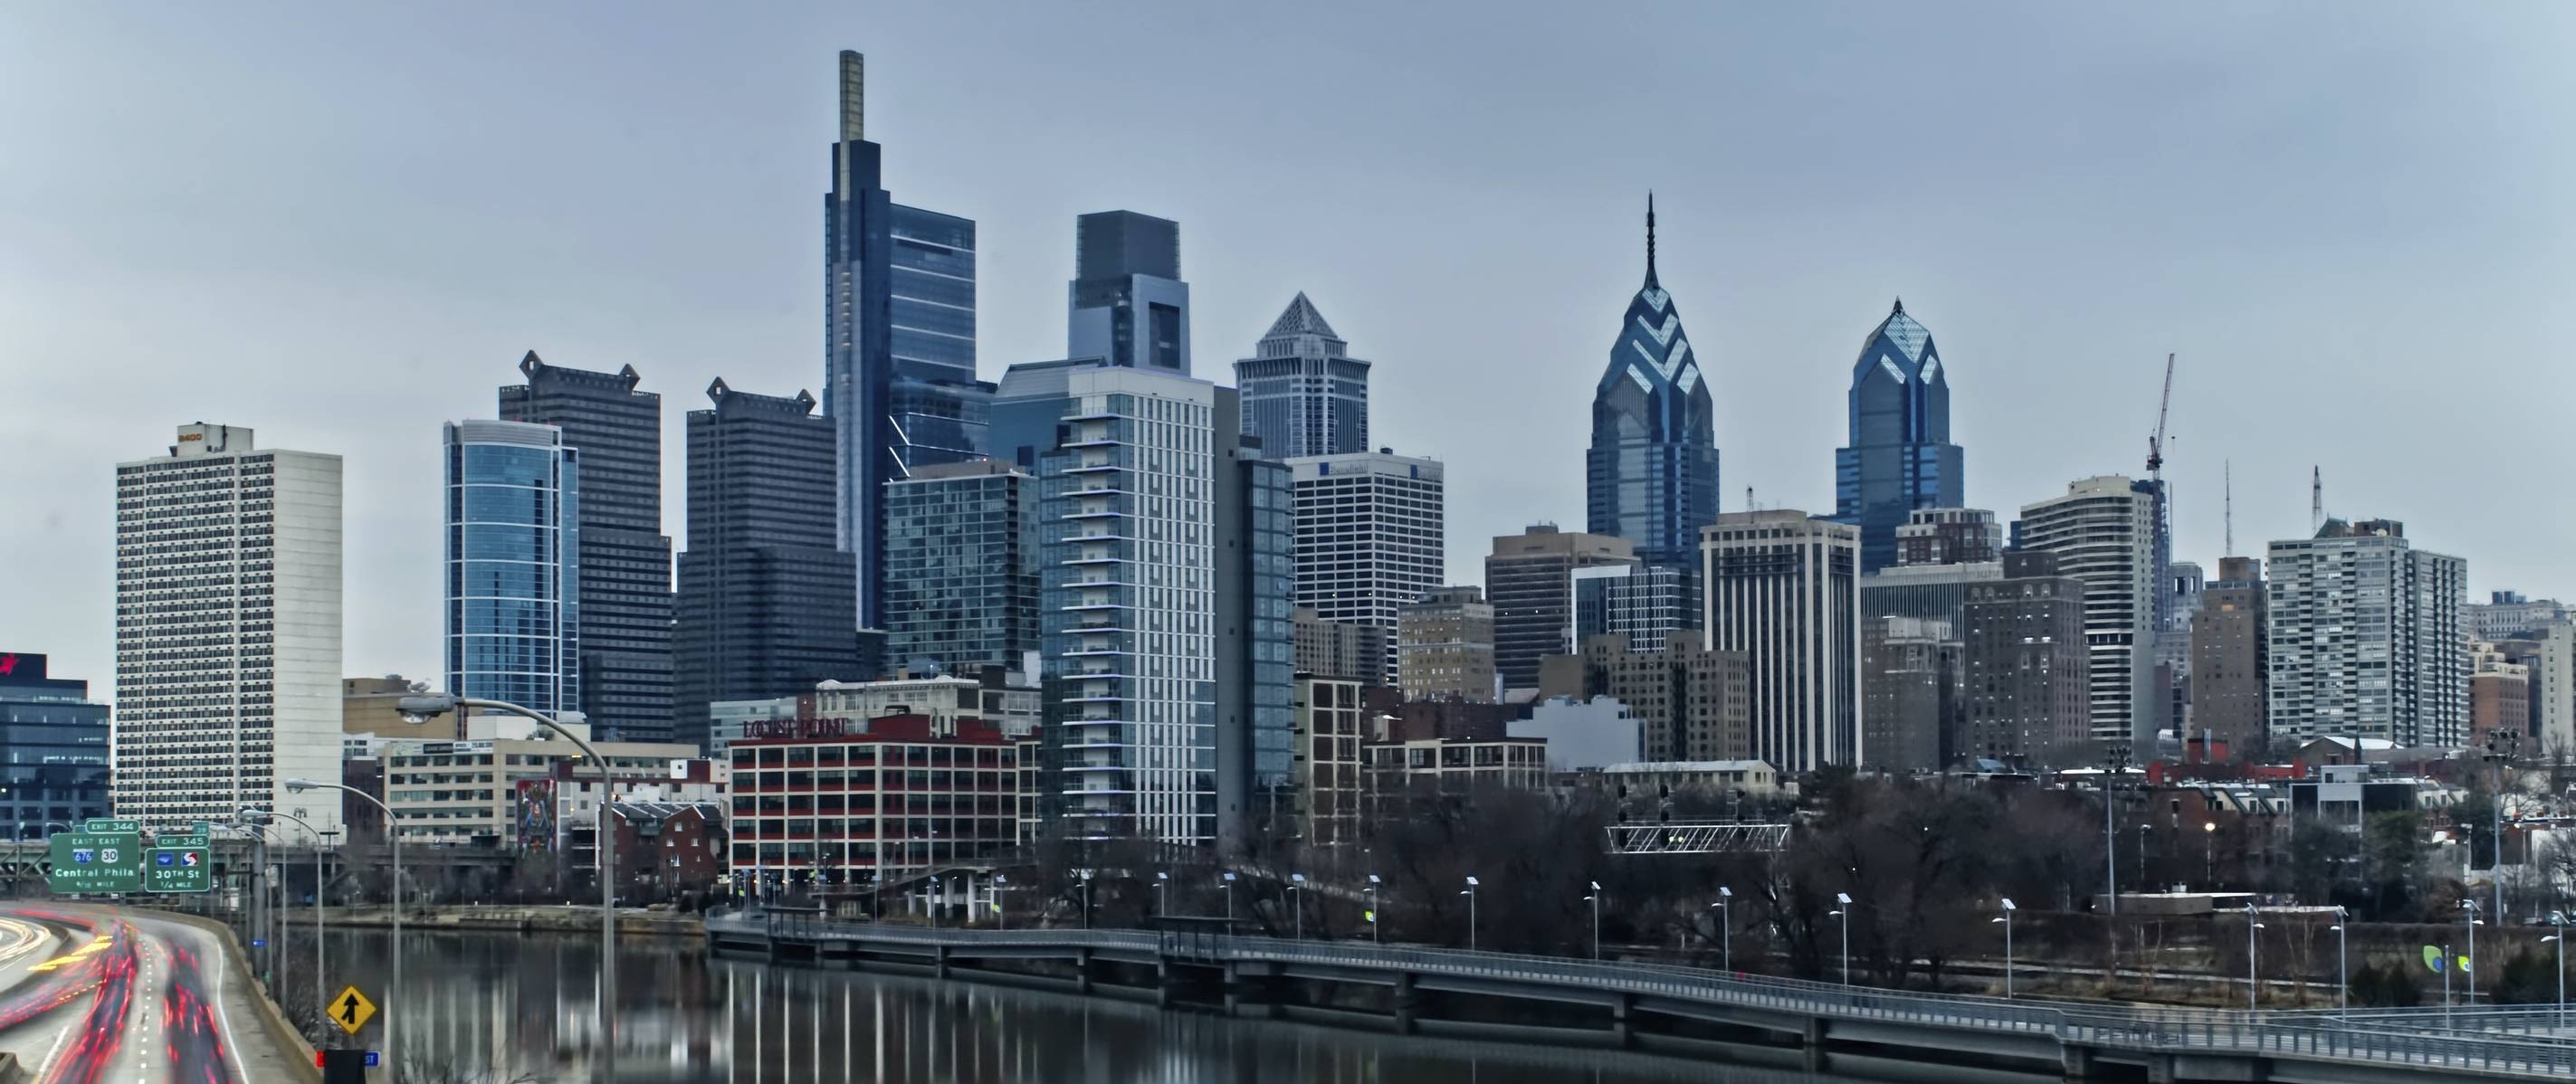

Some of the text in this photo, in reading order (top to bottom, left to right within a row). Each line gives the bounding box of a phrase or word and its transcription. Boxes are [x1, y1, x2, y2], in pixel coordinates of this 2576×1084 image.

[799, 717, 849, 738] POINT
[112, 823, 134, 831] 344
[183, 837, 204, 846] 345
[74, 851, 117, 861] 676 30
[55, 869, 134, 878] Central Phila
[156, 870, 200, 880] 30TH St
[160, 880, 174, 889] 1/4
